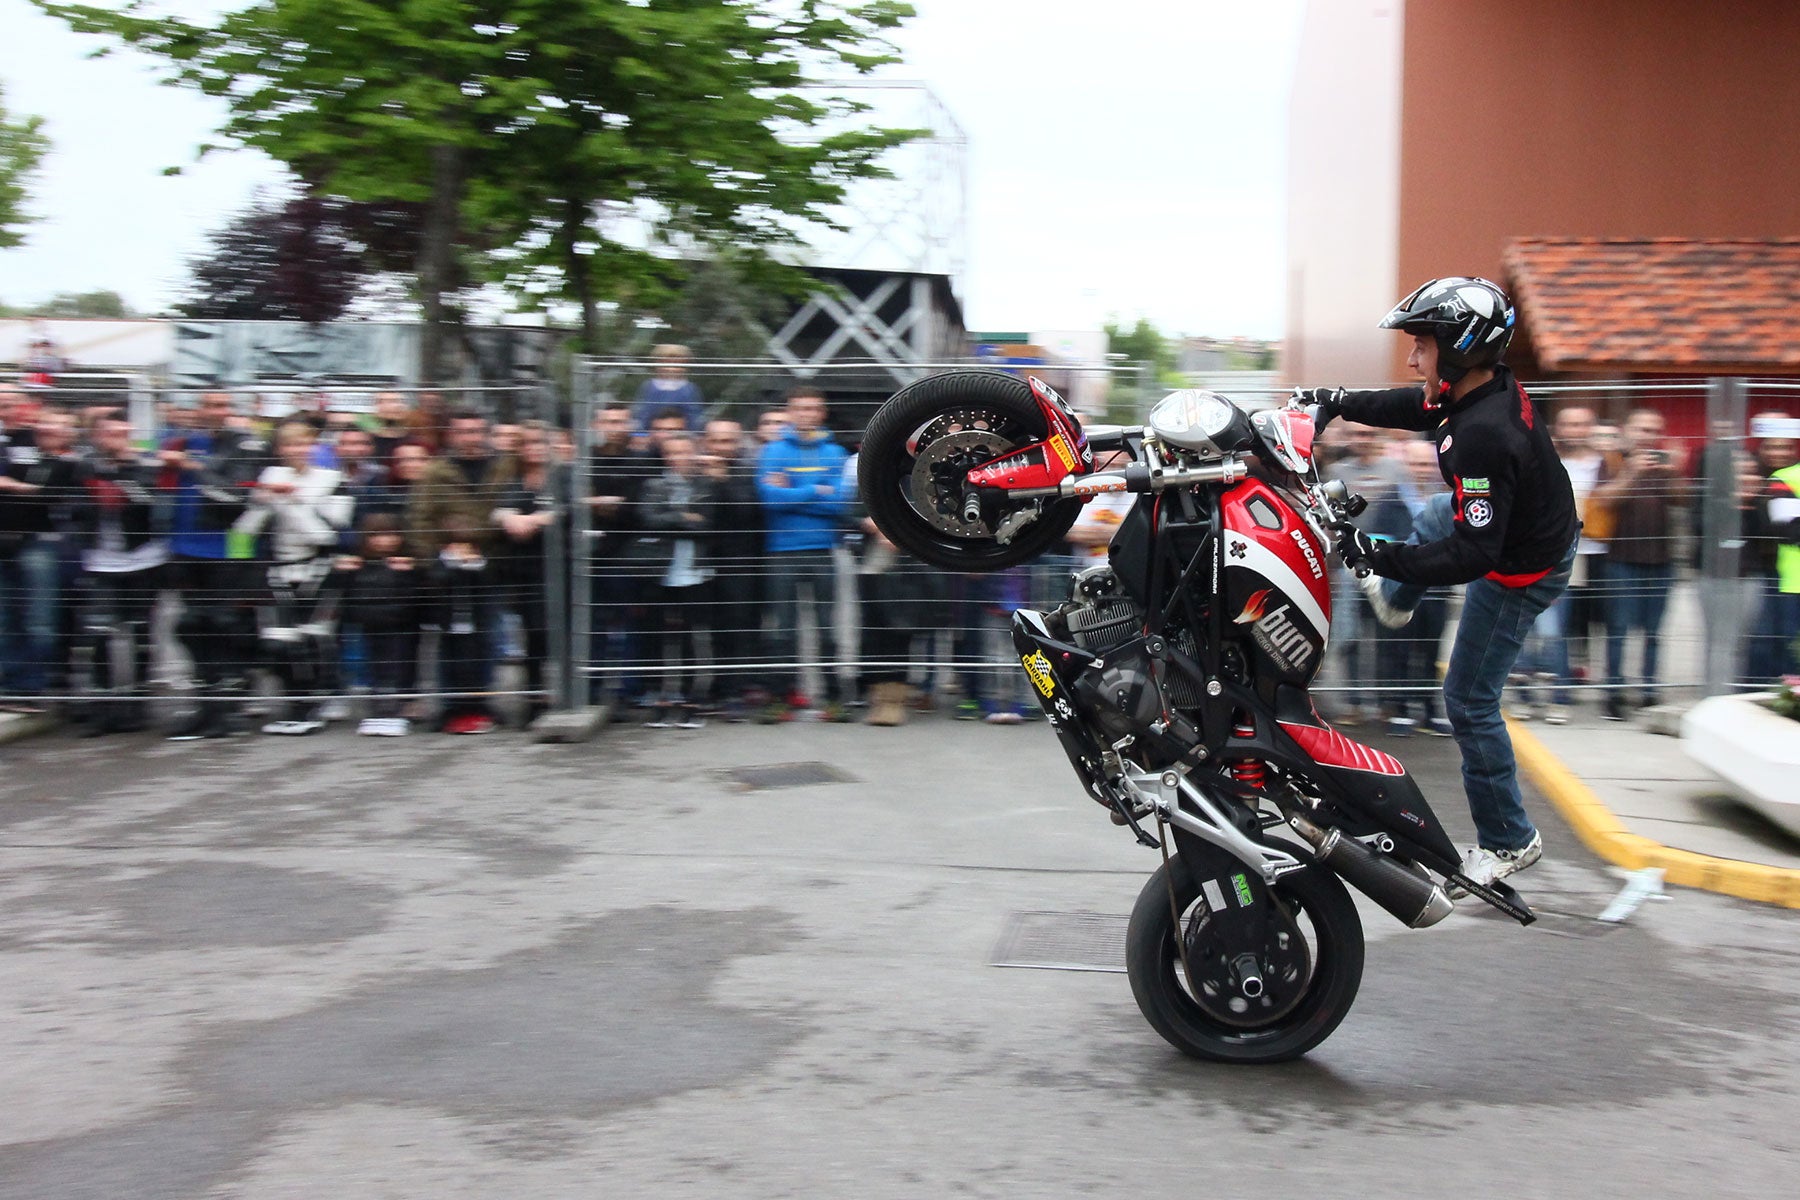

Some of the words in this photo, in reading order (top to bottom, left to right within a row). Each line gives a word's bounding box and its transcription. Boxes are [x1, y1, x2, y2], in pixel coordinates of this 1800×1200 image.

[1290, 529, 1323, 580] DUCATI
[1257, 604, 1313, 668] burn
[1024, 657, 1050, 694] BARDAHL
[1271, 651, 1290, 671] DRINK
